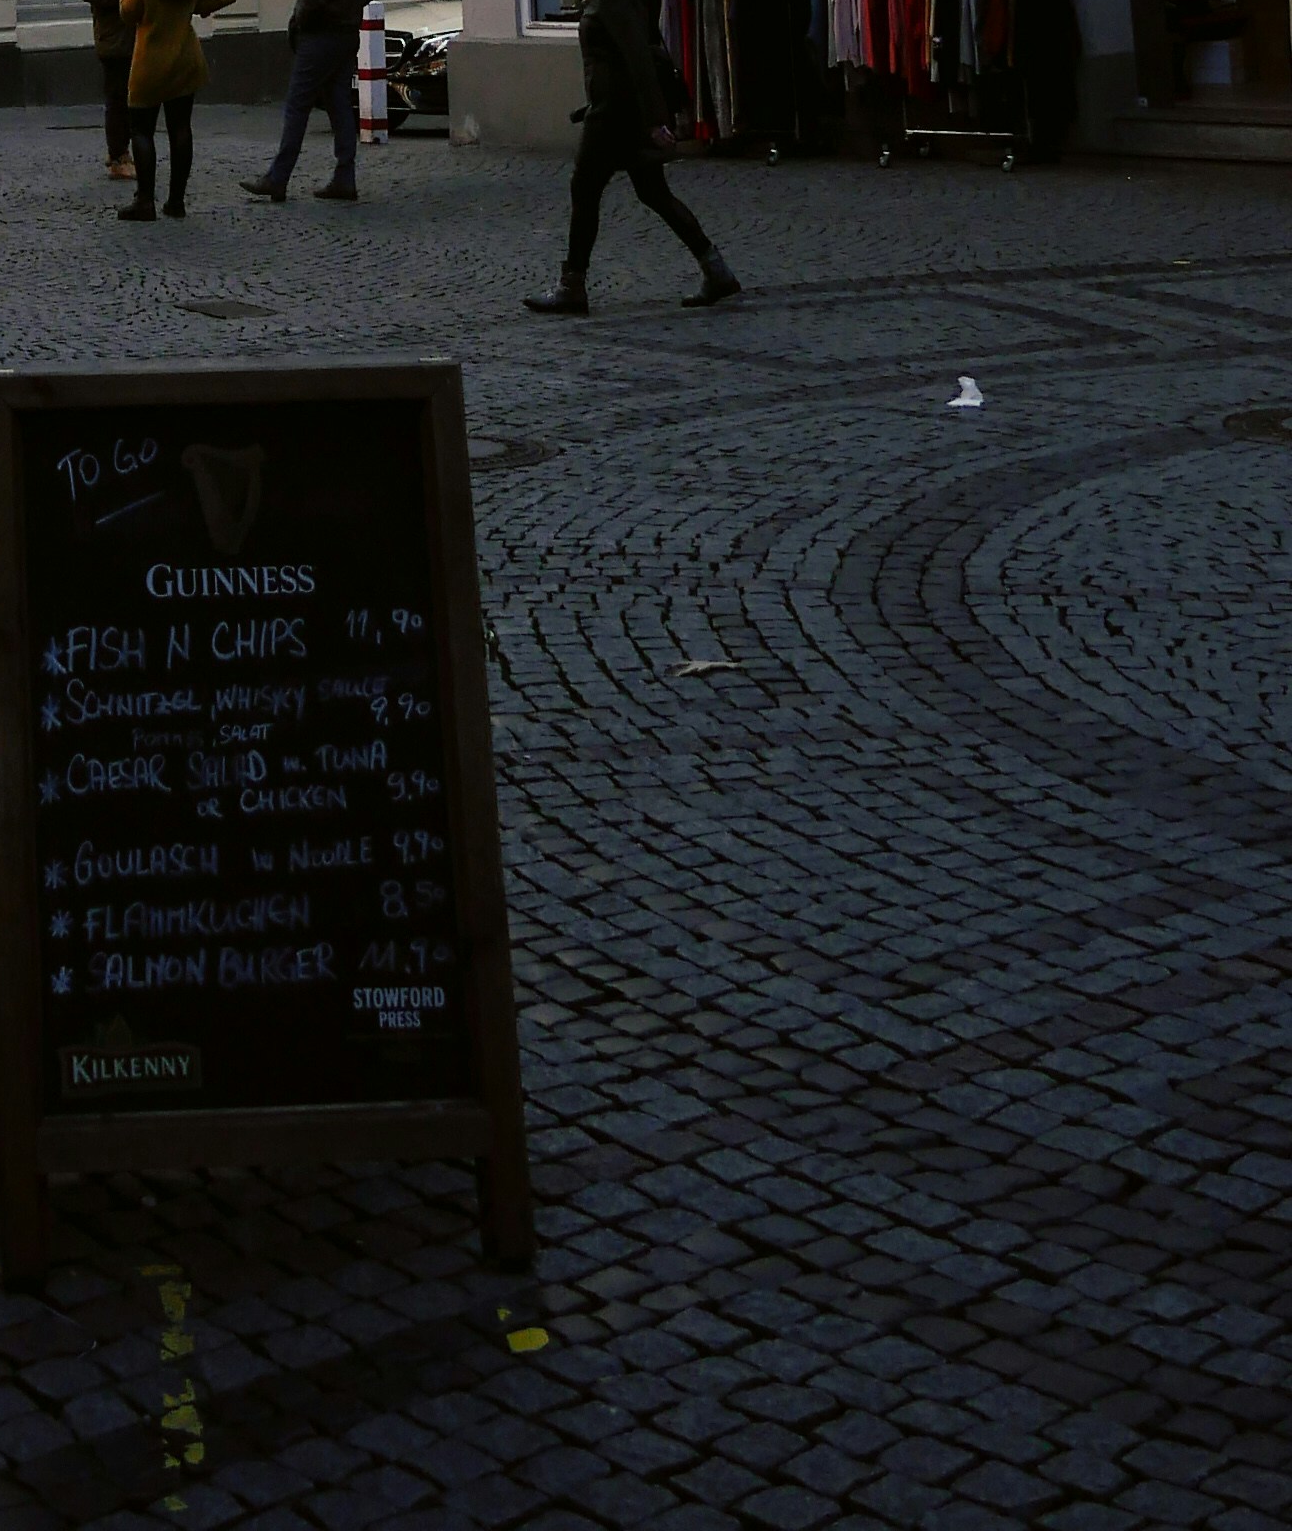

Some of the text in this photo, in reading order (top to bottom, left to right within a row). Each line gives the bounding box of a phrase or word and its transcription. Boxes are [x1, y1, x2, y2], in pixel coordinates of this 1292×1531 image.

[56, 437, 159, 503] TO GO
[144, 562, 316, 598] GUINNESS
[66, 625, 146, 673] FISH
[166, 621, 191, 670] N
[211, 616, 308, 661] CHIPS
[66, 753, 172, 796] CAESAR
[185, 748, 269, 792] SALAD
[314, 739, 389, 774] TUNA
[239, 784, 348, 814] CHICKEN
[73, 840, 220, 885] GOULASCH
[83, 893, 313, 943] FLAMMKUCHEN
[85, 947, 208, 994] SALMON
[216, 940, 339, 989] BURGER
[351, 985, 446, 1010] STOWFORD
[378, 1010, 422, 1029] PRESS
[71, 1054, 194, 1086] KILKENNY
